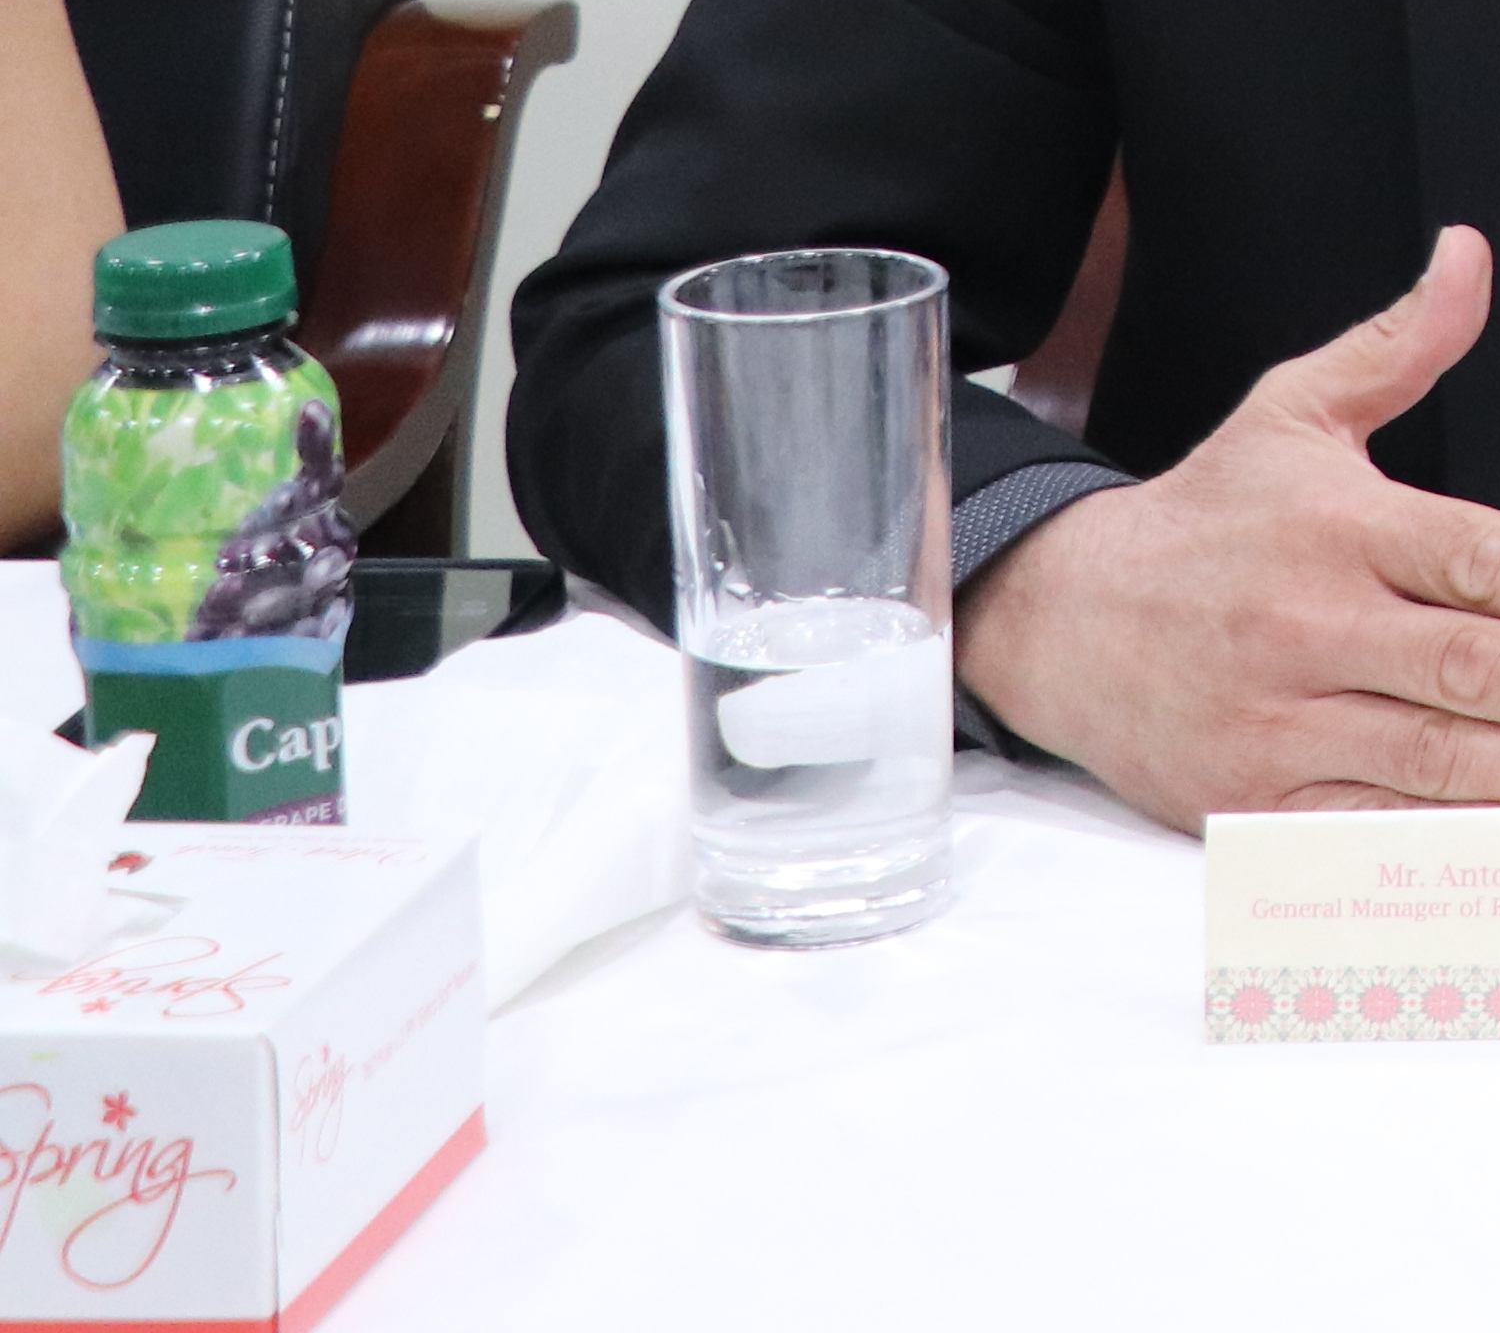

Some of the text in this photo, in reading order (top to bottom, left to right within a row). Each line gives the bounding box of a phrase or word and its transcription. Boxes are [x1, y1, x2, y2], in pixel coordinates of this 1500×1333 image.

[1377, 862, 1426, 889] Mr.
[1251, 898, 1342, 920] General
[1350, 898, 1450, 925] Manager
[1459, 896, 1487, 919] of
